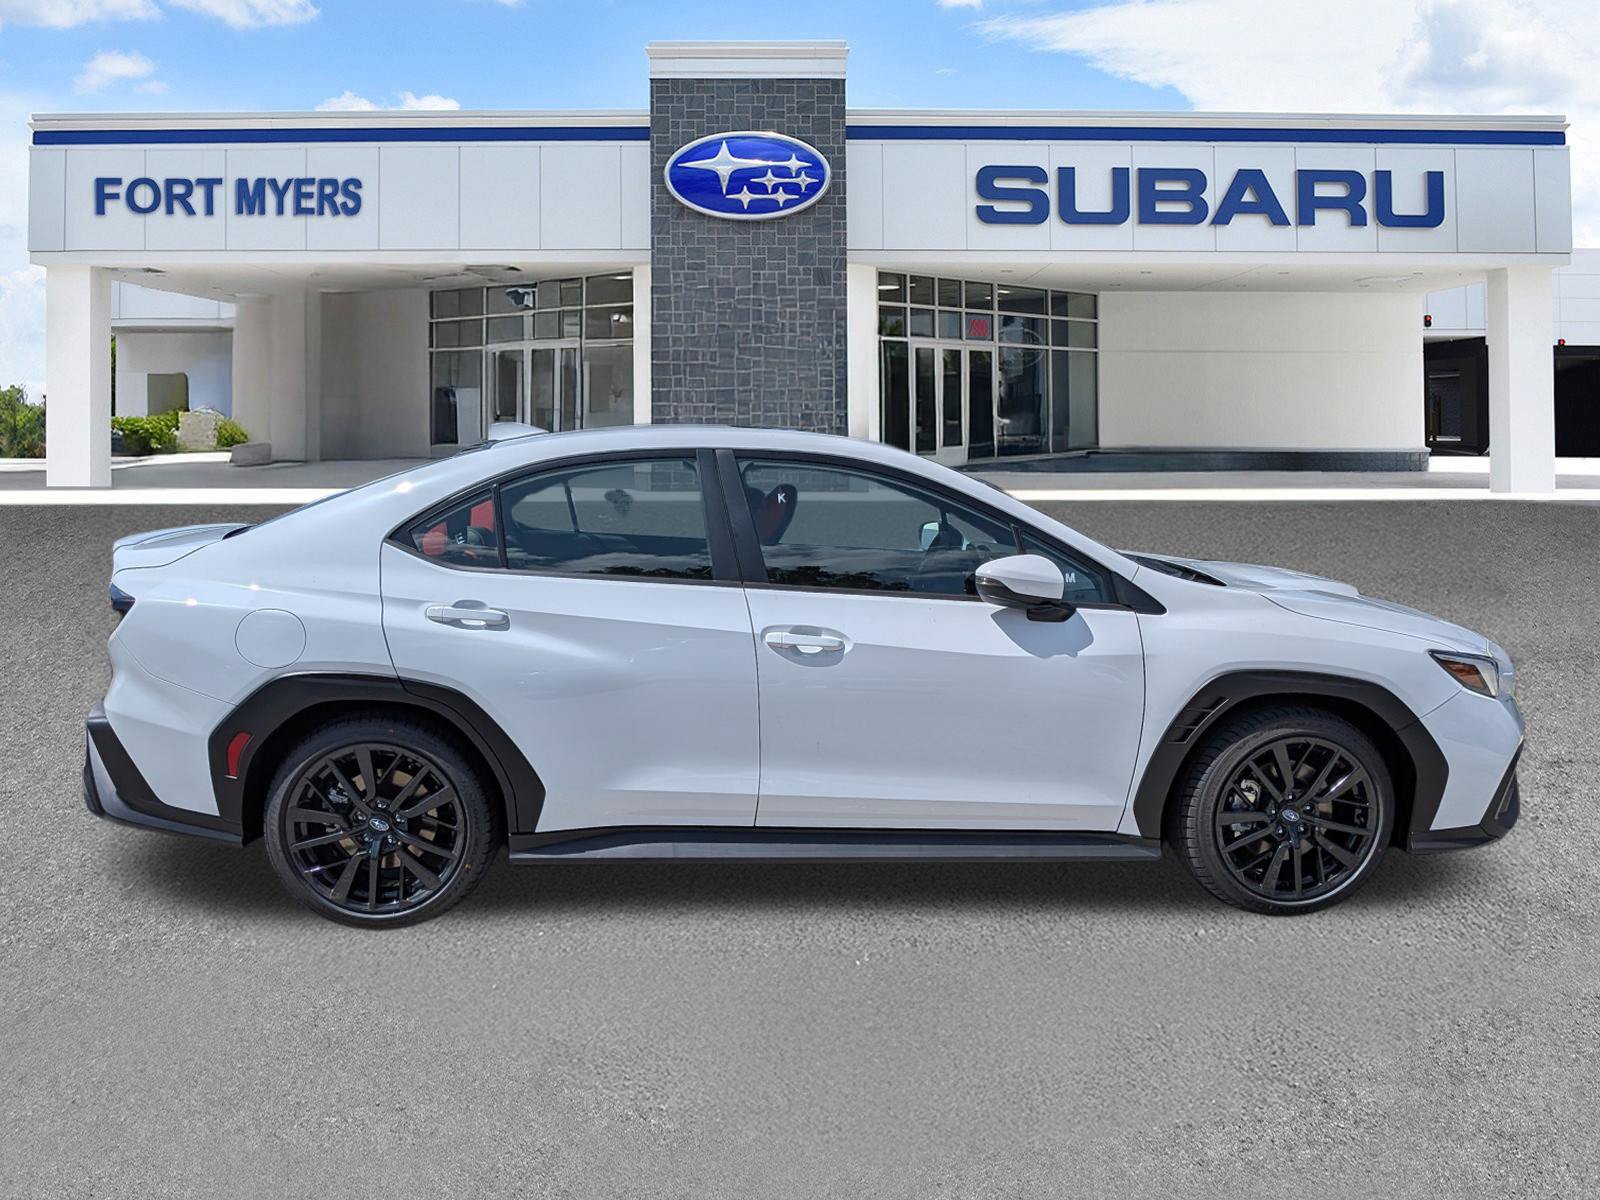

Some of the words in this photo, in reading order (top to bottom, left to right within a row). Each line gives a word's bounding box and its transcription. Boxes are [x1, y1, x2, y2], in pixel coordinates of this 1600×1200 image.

[95, 177, 222, 216] FORT
[235, 177, 363, 216] MYERS
[975, 165, 1445, 228] SUBARU
[777, 493, 786, 504] K
[1065, 572, 1076, 583] M
